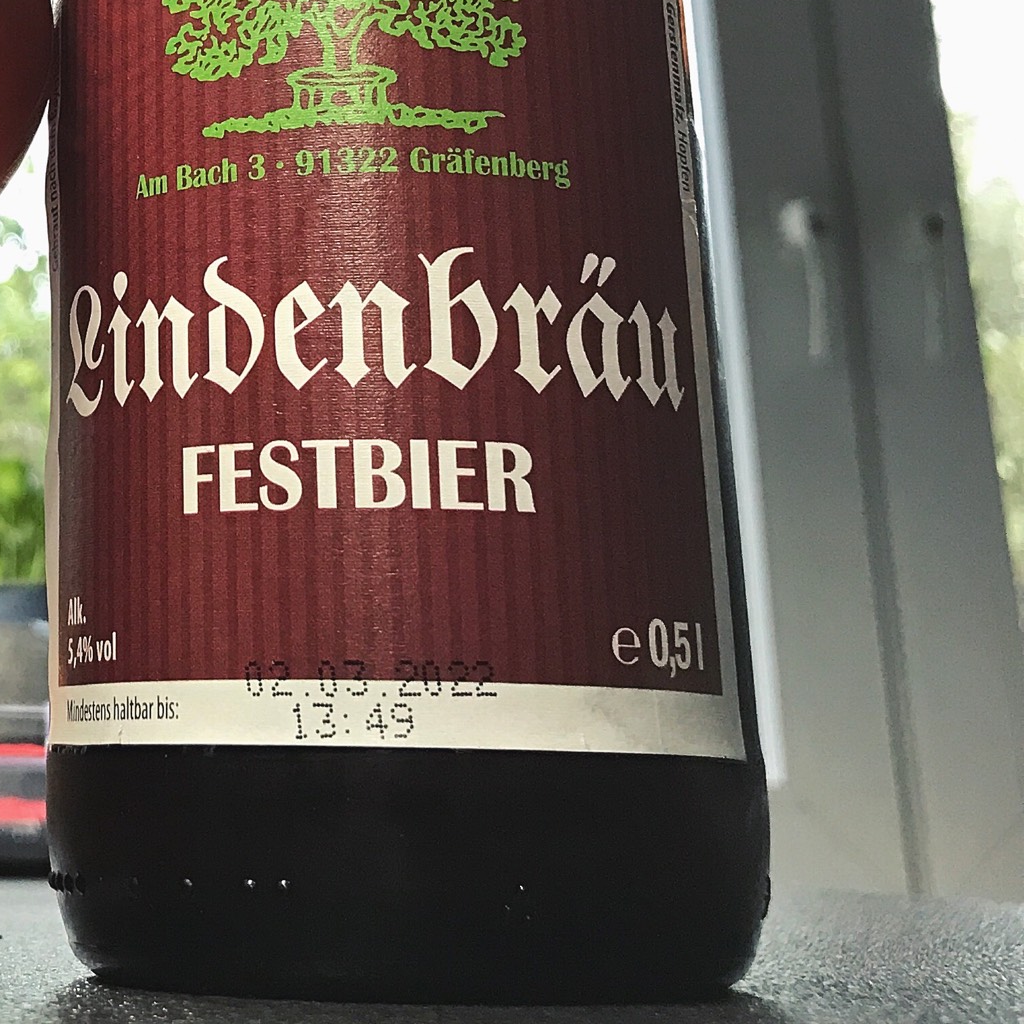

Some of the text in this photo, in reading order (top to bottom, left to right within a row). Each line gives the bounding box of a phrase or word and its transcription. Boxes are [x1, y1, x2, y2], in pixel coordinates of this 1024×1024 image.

[135, 146, 571, 200] Am Bach 3 91322 Gräfenberg
[677, 129, 693, 192] Hopfen
[66, 246, 685, 417] Lindenbräu
[181, 439, 537, 515] FESTBIER
[67, 596, 87, 626] Alk.
[67, 631, 117, 669] 5,4% vol
[244, 659, 498, 697] 02.03.2022
[66, 695, 179, 722] Mindestens haltbar bis:
[293, 702, 414, 740] 13:49
